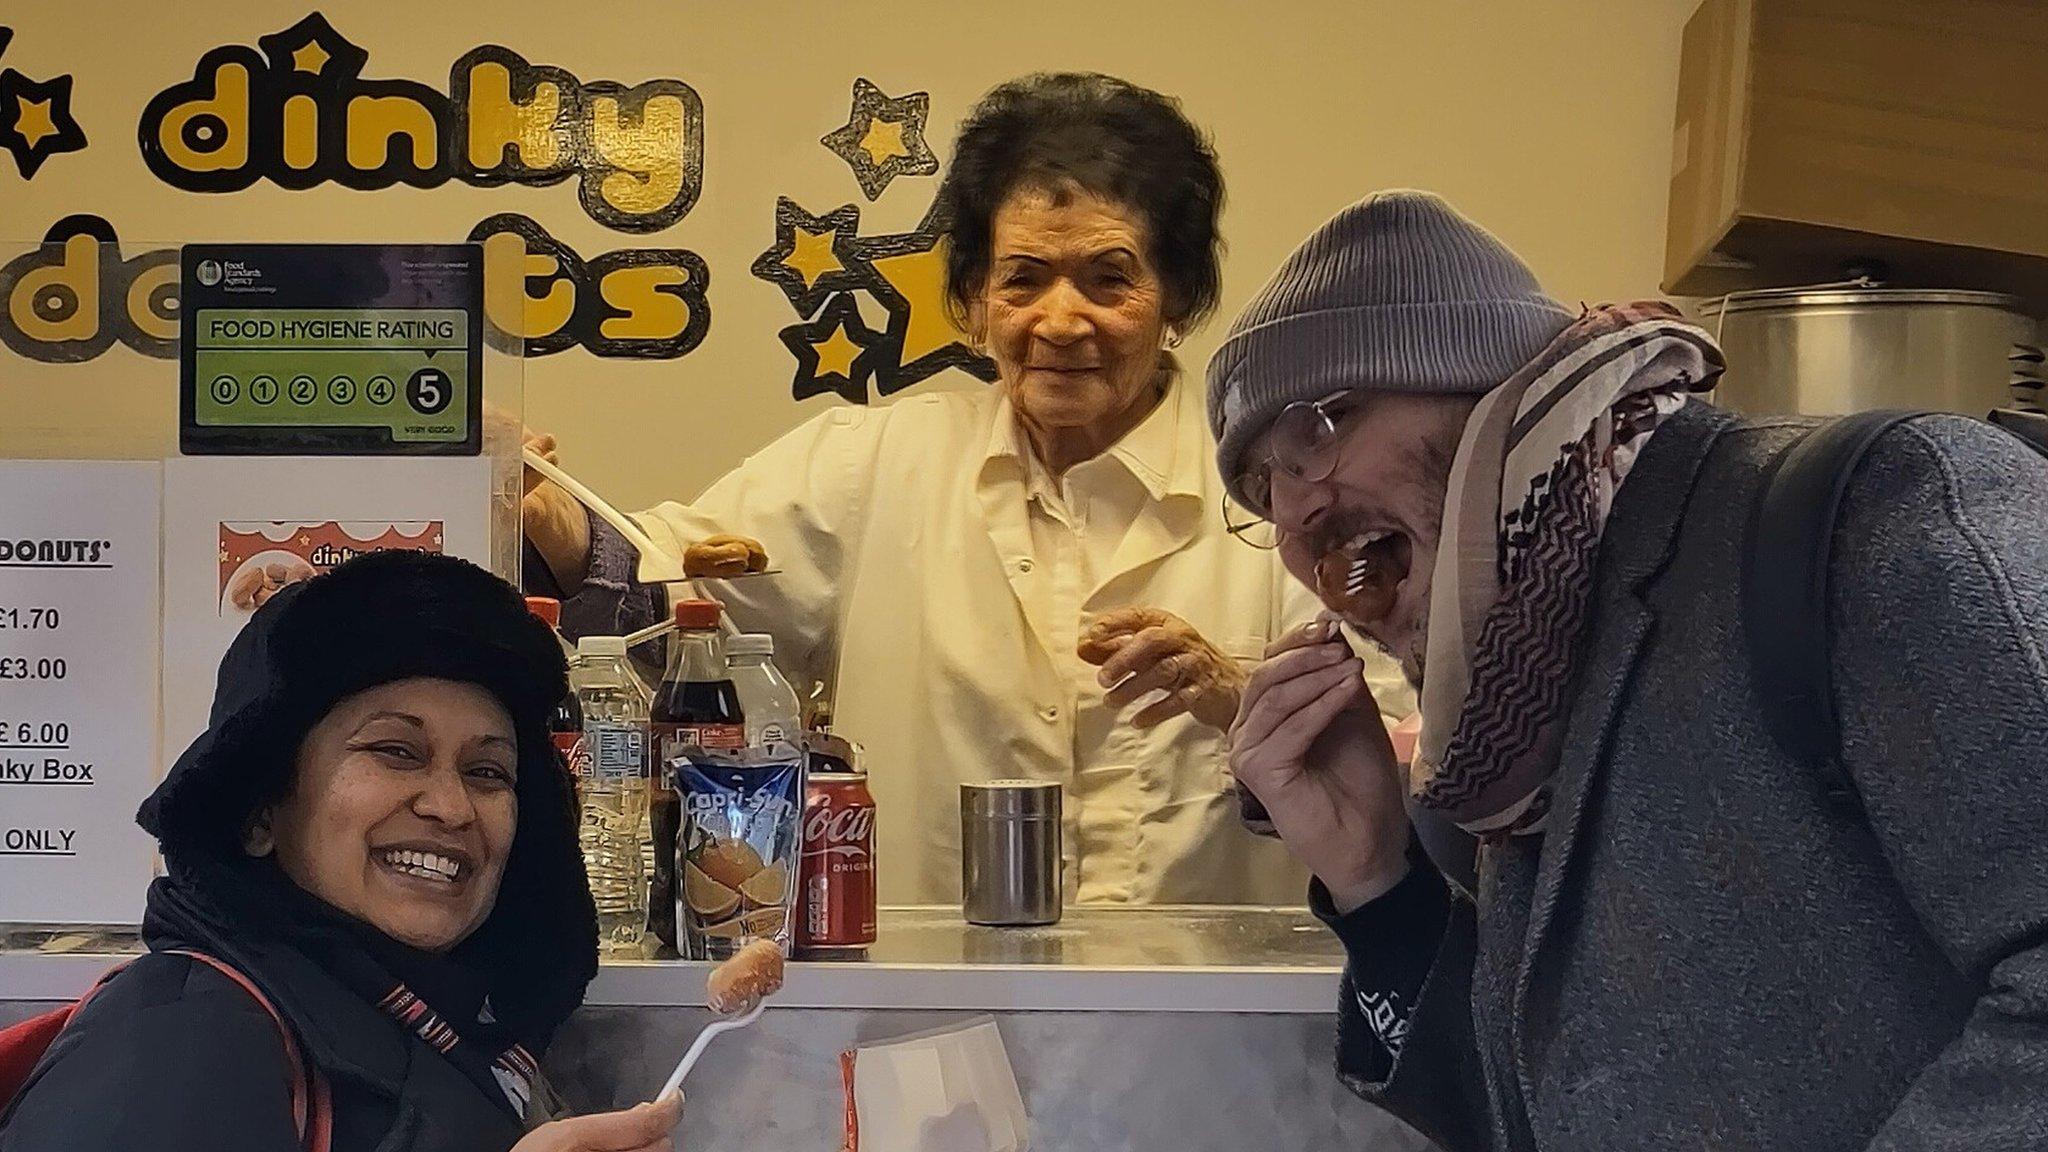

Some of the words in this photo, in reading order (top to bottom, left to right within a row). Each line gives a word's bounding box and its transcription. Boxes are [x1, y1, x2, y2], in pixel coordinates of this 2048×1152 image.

[150, 50, 696, 224] dinky
[210, 320, 275, 339] FOOD
[281, 320, 372, 340] HYGIENE
[377, 321, 454, 339] RATING
[218, 381, 231, 399] 0
[297, 381, 309, 399] 2
[336, 381, 347, 399] 3
[375, 382, 387, 399] 4
[418, 374, 441, 408] 5
[0, 657, 67, 680] £3.00
[18, 723, 69, 744] 6.00
[44, 759, 94, 780] Box
[5, 829, 76, 850] ONLY
